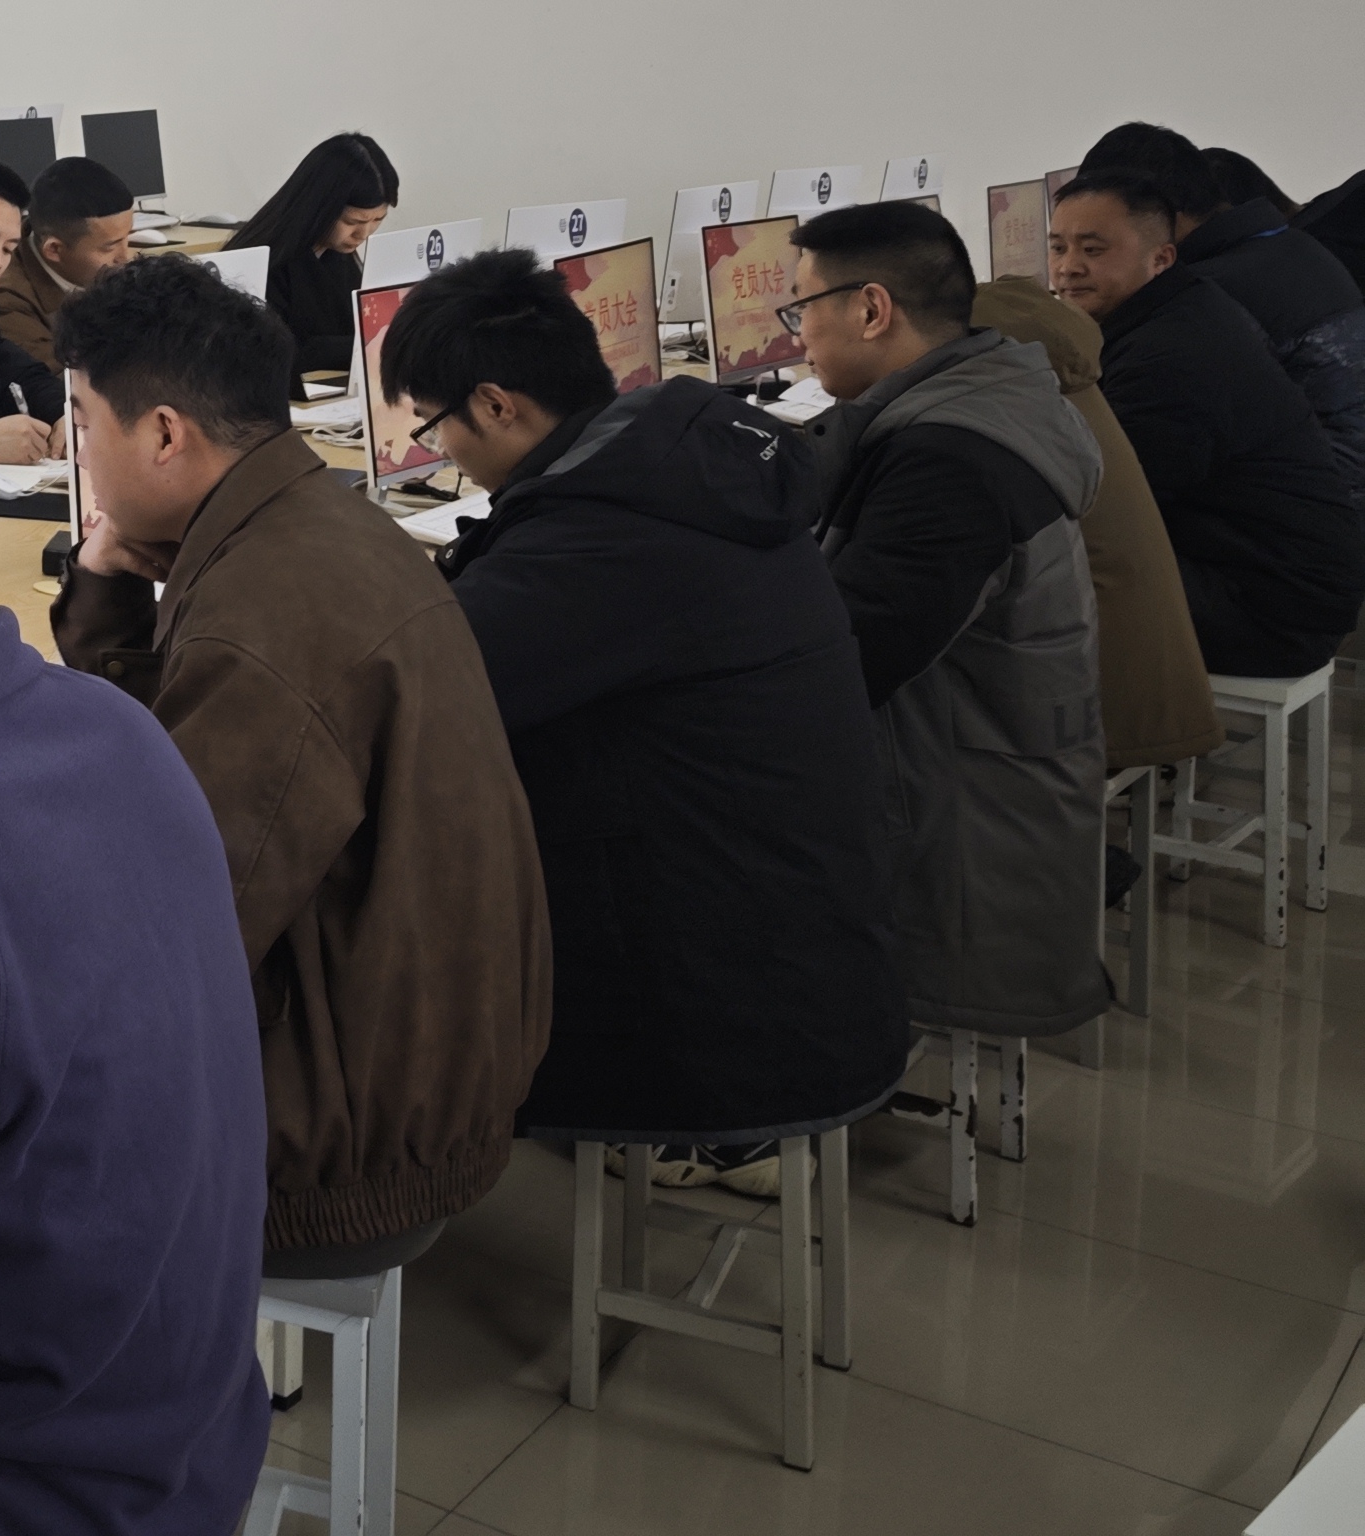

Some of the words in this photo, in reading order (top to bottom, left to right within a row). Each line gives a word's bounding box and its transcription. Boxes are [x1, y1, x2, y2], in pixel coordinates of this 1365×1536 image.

[571, 215, 584, 232] 27
[429, 235, 442, 256] 26
[732, 260, 784, 301] 党员大会
